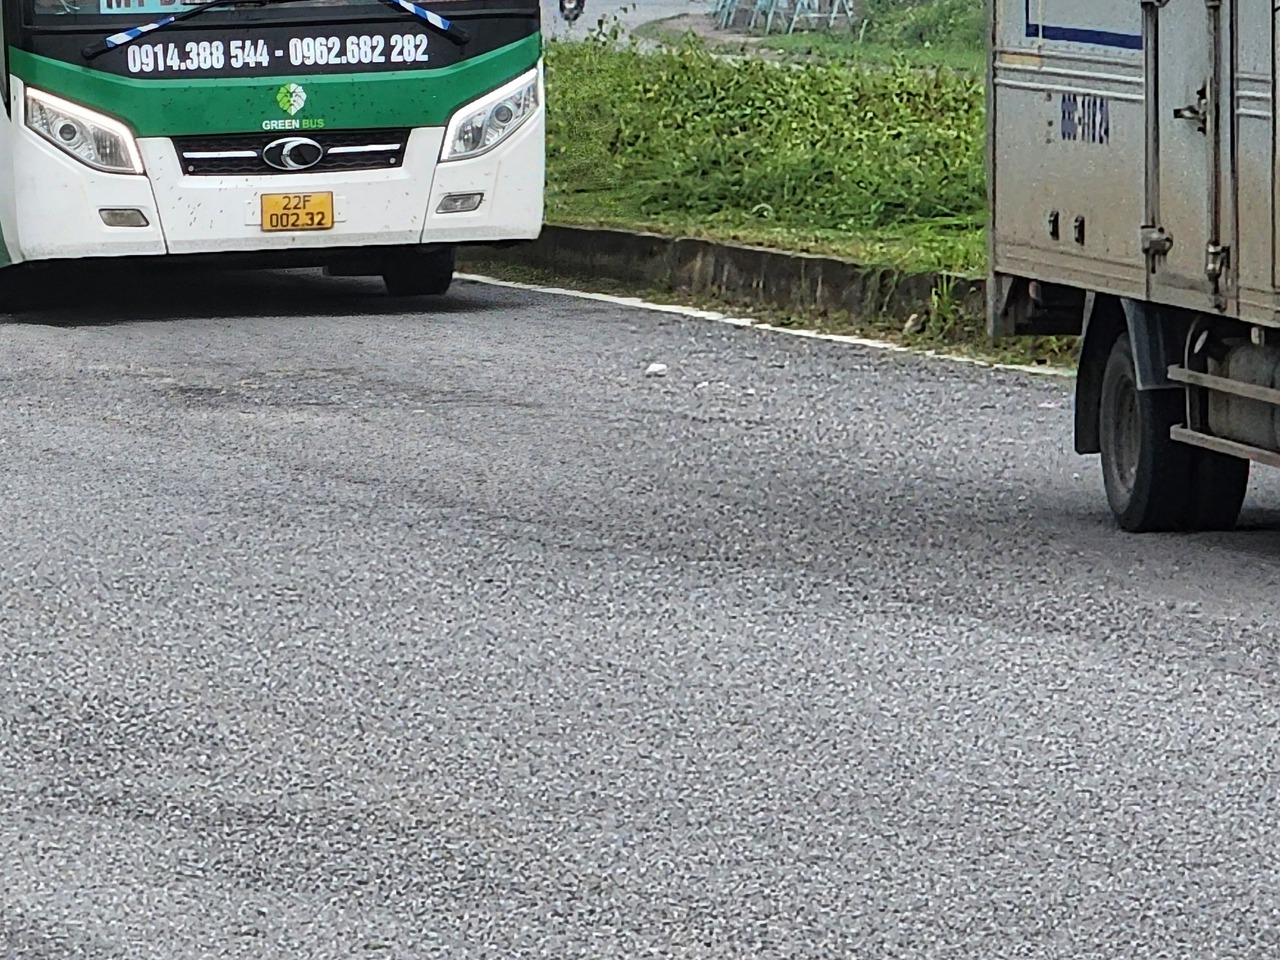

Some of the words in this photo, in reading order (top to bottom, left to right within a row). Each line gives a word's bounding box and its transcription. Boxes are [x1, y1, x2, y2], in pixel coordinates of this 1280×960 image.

[127, 40, 225, 73] 0914.388
[230, 39, 269, 68] 544
[288, 35, 386, 66] 0962.682
[390, 33, 429, 63] 282
[262, 119, 300, 130] GREEN
[302, 118, 325, 128] BUS
[282, 195, 312, 210] 22F
[270, 211, 326, 228] 002.32
